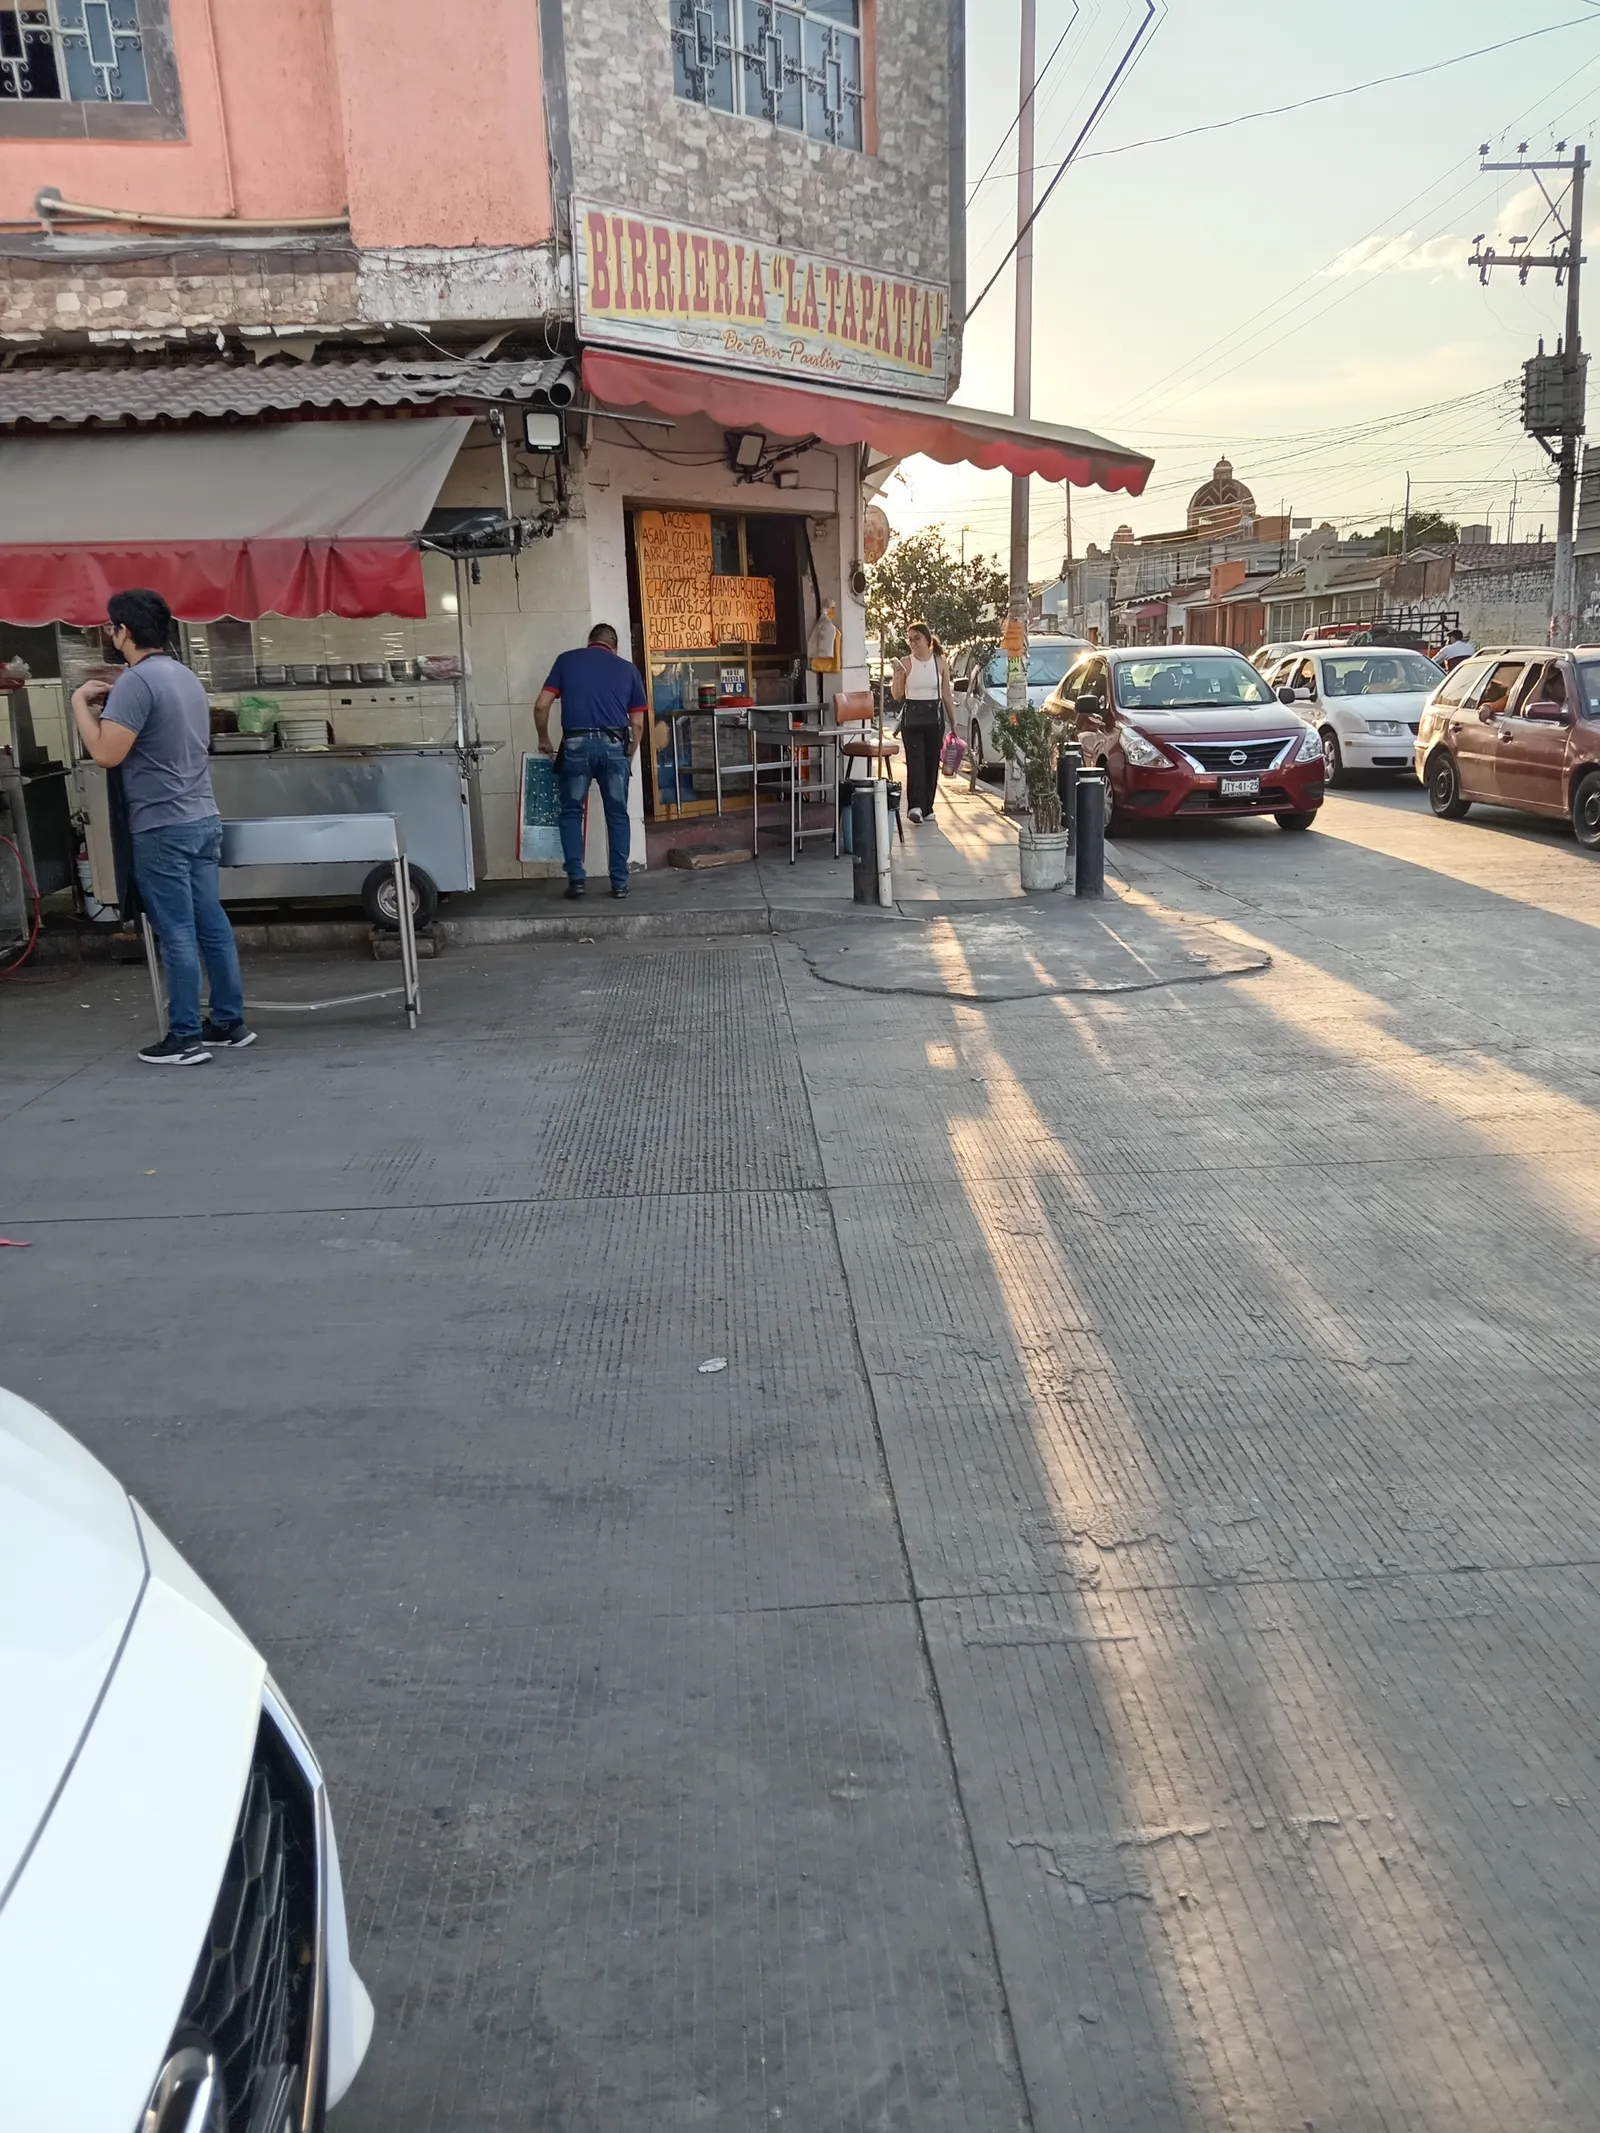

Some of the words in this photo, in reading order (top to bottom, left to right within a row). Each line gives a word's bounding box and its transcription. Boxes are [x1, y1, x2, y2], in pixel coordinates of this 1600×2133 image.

[586, 211, 767, 319] BIRRIERIA
[723, 329, 745, 352] De
[750, 334, 783, 360] Don
[659, 511, 692, 530] TACOS
[642, 527, 670, 546] ASADA
[672, 531, 710, 551] COSTILLA
[643, 546, 697, 566] ARRACHERA
[697, 555, 713, 573] $30
[647, 579, 690, 598] CHORIZO
[711, 577, 774, 600] HAMBURGUESA
[686, 598, 712, 615] $120
[713, 600, 732, 617] CON
[735, 600, 758, 618] PAPAS
[758, 600, 774, 620] $80
[650, 615, 678, 633] ELOTE
[649, 631, 684, 649] COSTILLA
[686, 631, 703, 648] BBQ
